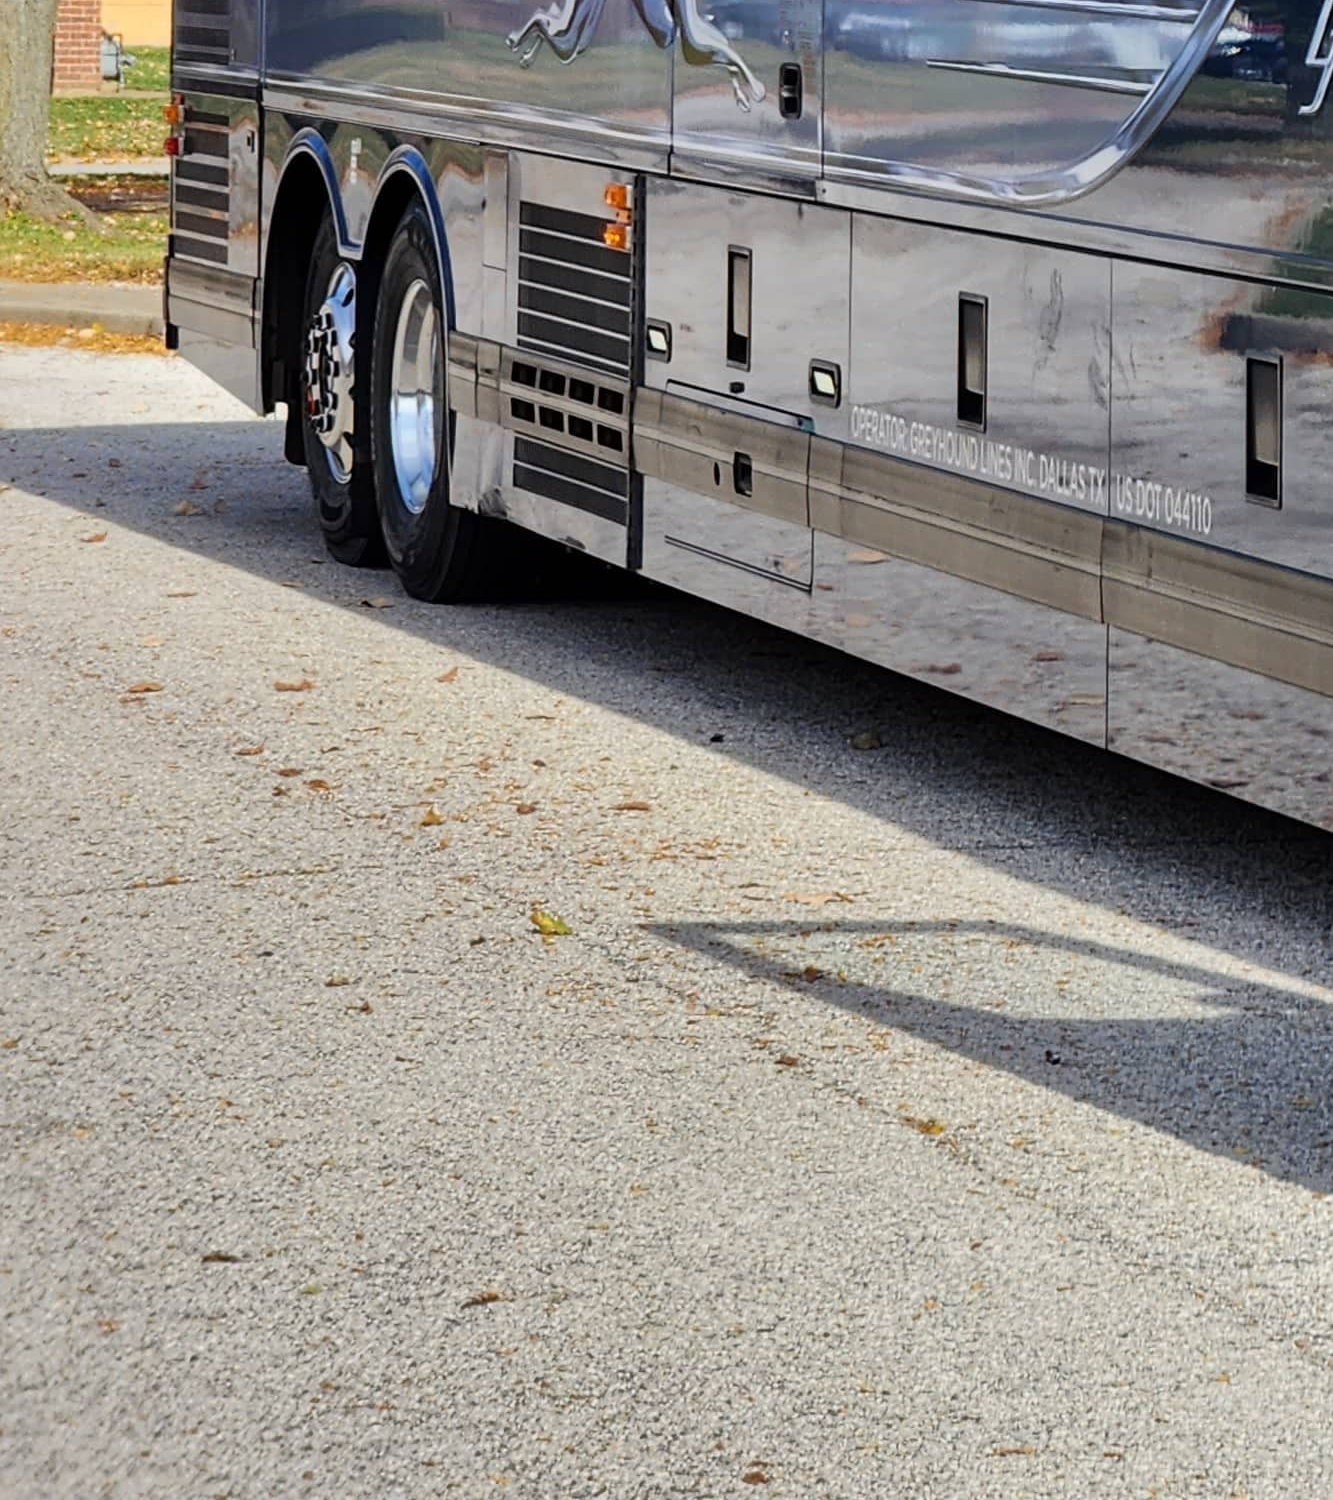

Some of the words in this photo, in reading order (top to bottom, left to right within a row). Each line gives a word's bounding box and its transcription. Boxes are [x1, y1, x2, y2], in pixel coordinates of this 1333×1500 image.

[910, 421, 979, 471] GREYHOUND
[980, 438, 1012, 482] LINES
[1039, 454, 1086, 500] DALLAS
[1116, 473, 1134, 513] US
[1136, 479, 1163, 521] DOT
[1164, 486, 1213, 536] 044110
